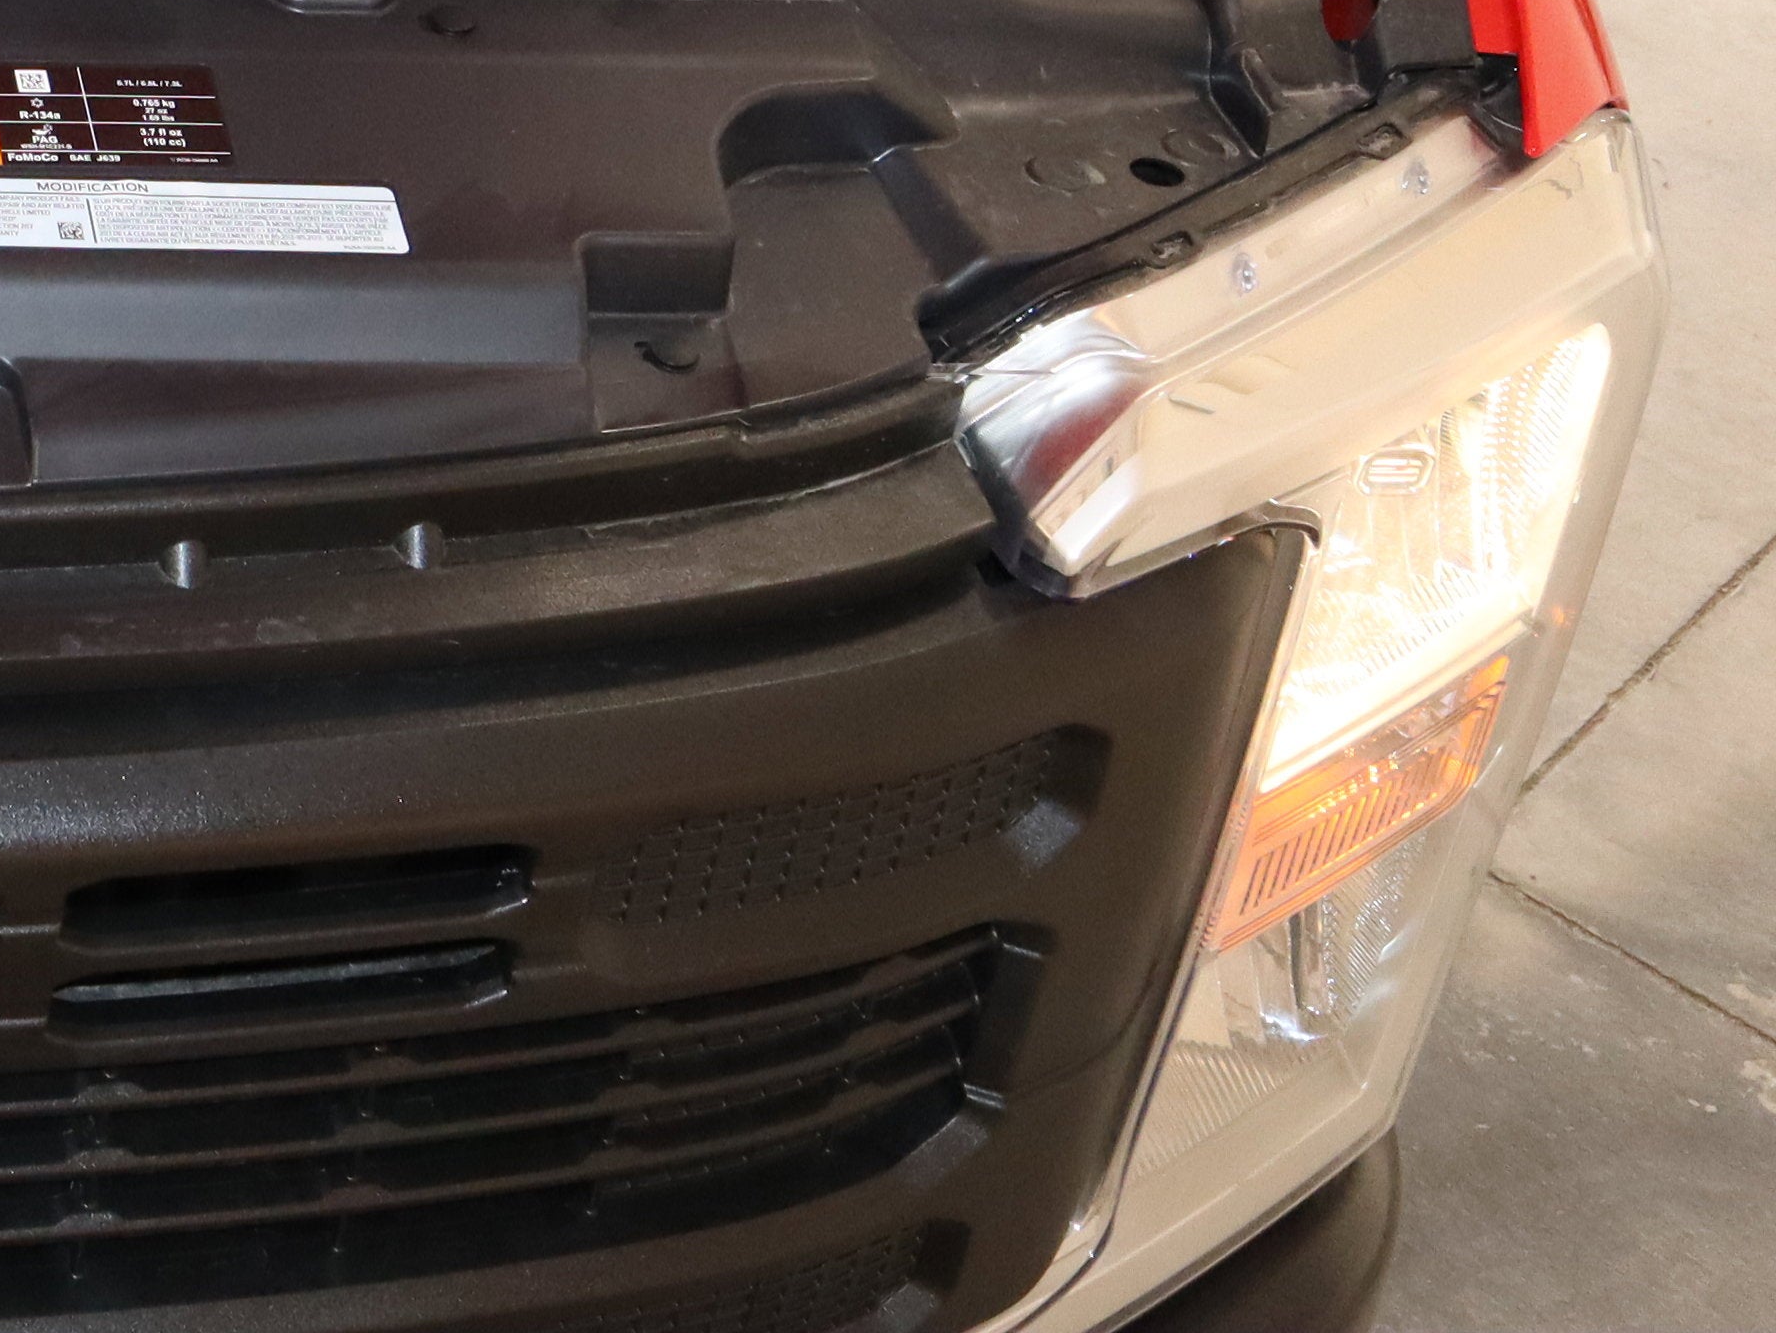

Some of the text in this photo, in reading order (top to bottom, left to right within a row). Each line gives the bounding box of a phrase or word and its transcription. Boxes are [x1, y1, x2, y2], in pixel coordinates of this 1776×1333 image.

[133, 99, 175, 109] 0.765 kg
[18, 111, 61, 120] R-134a
[140, 128, 155, 136] 3.7
[143, 139, 186, 147] (110 cc)
[7, 153, 120, 162] FoMoCo SAE J639
[36, 182, 148, 192] MODIFICATION
